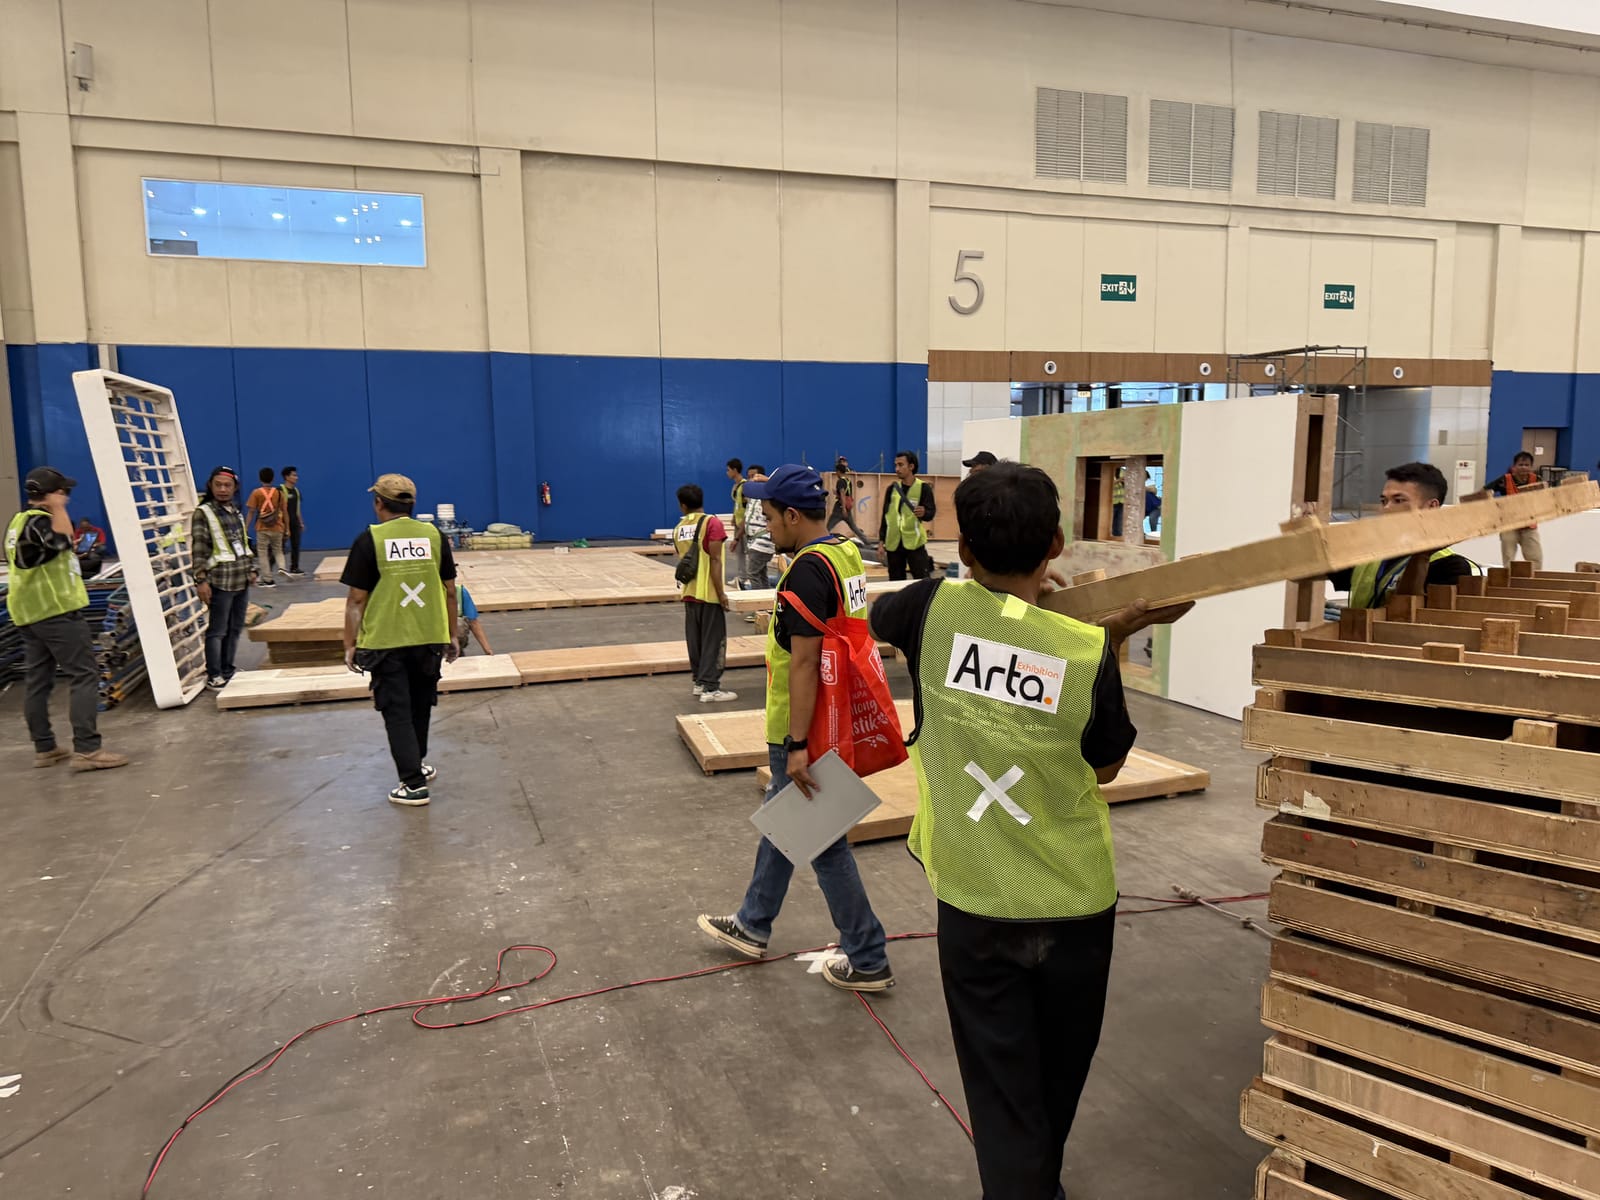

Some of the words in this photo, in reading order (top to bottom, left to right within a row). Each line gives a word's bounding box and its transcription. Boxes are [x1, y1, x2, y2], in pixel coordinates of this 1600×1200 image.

[948, 249, 985, 316] 5
[1101, 283, 1119, 292] EXIT
[1325, 292, 1339, 300] EXIT
[679, 527, 697, 540] Art
[1017, 661, 1059, 679] Exhibition
